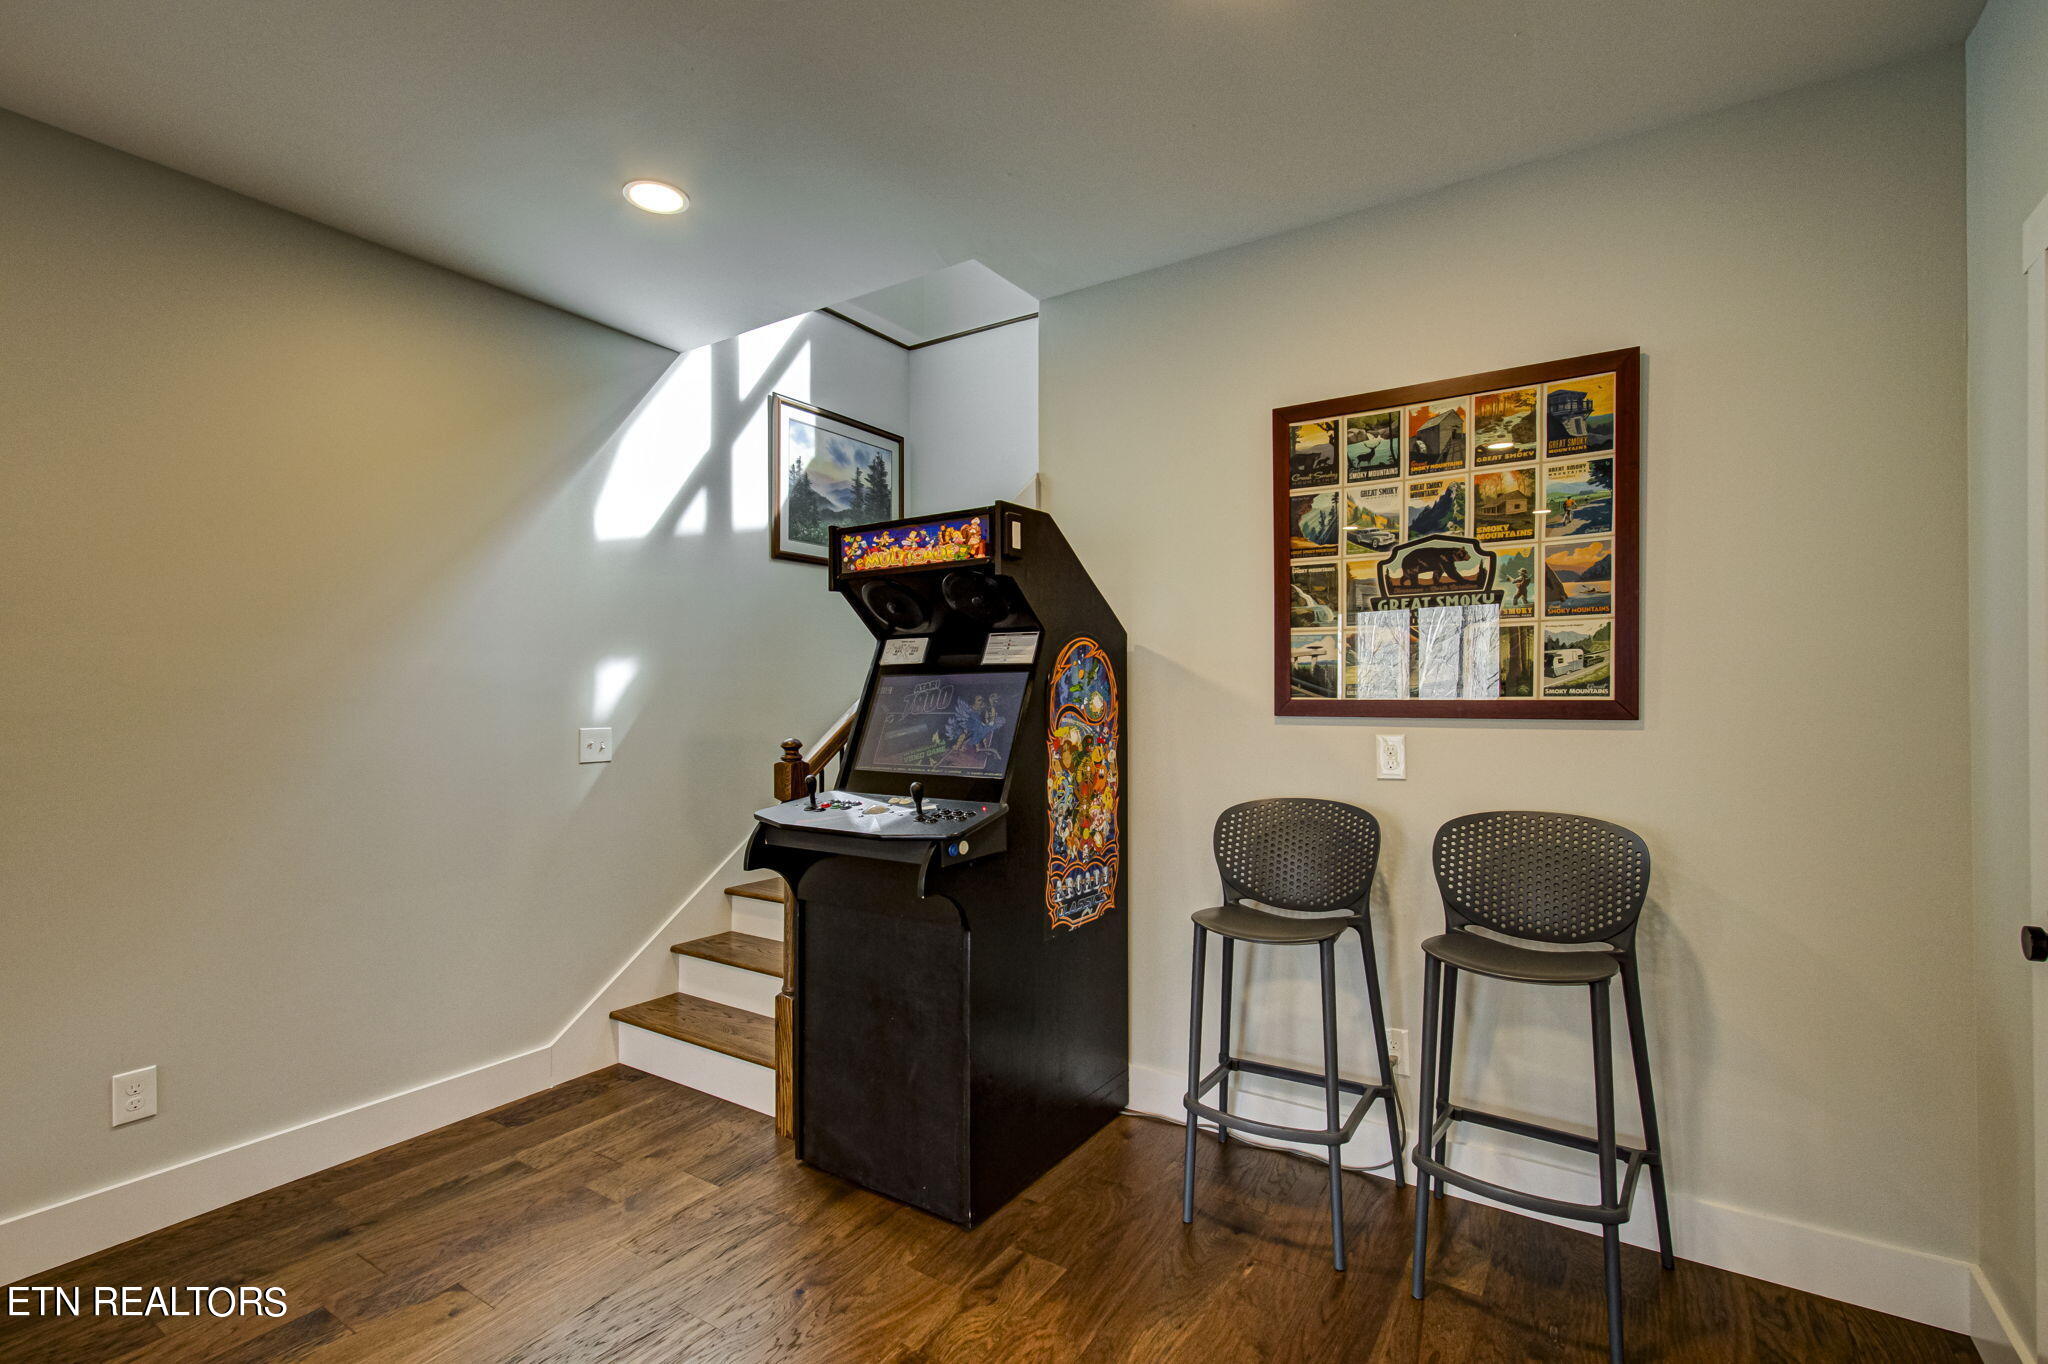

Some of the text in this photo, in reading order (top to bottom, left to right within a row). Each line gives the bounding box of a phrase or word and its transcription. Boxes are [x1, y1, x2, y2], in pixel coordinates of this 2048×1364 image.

[1548, 435, 1588, 449] GREAT SMOKY
[1548, 445, 1588, 454] MOUNTAINS
[1476, 455, 1502, 464] GREAT
[1503, 450, 1536, 460] SMOKY
[1430, 459, 1464, 469] MOUNTAINS
[1548, 463, 1587, 473] GREAT SMOKY
[1349, 470, 1368, 480] SMOKY
[1368, 467, 1399, 478] MOUNTAINS
[1360, 488, 1378, 498] GREAT
[1378, 486, 1399, 496] SMOKY
[1410, 481, 1444, 492] GREAT SMOKY
[1410, 489, 1439, 498] MOUNTAINS
[1476, 523, 1510, 534] SMOKY
[1476, 528, 1534, 541] MOUNTAINS
[1377, 596, 1431, 611] GREAT
[1502, 607, 1533, 615] SMOKY
[1547, 605, 1610, 615] SMOKY MOUNTAINS
[913, 679, 942, 694] ATARI
[903, 751, 925, 763] VIDEO
